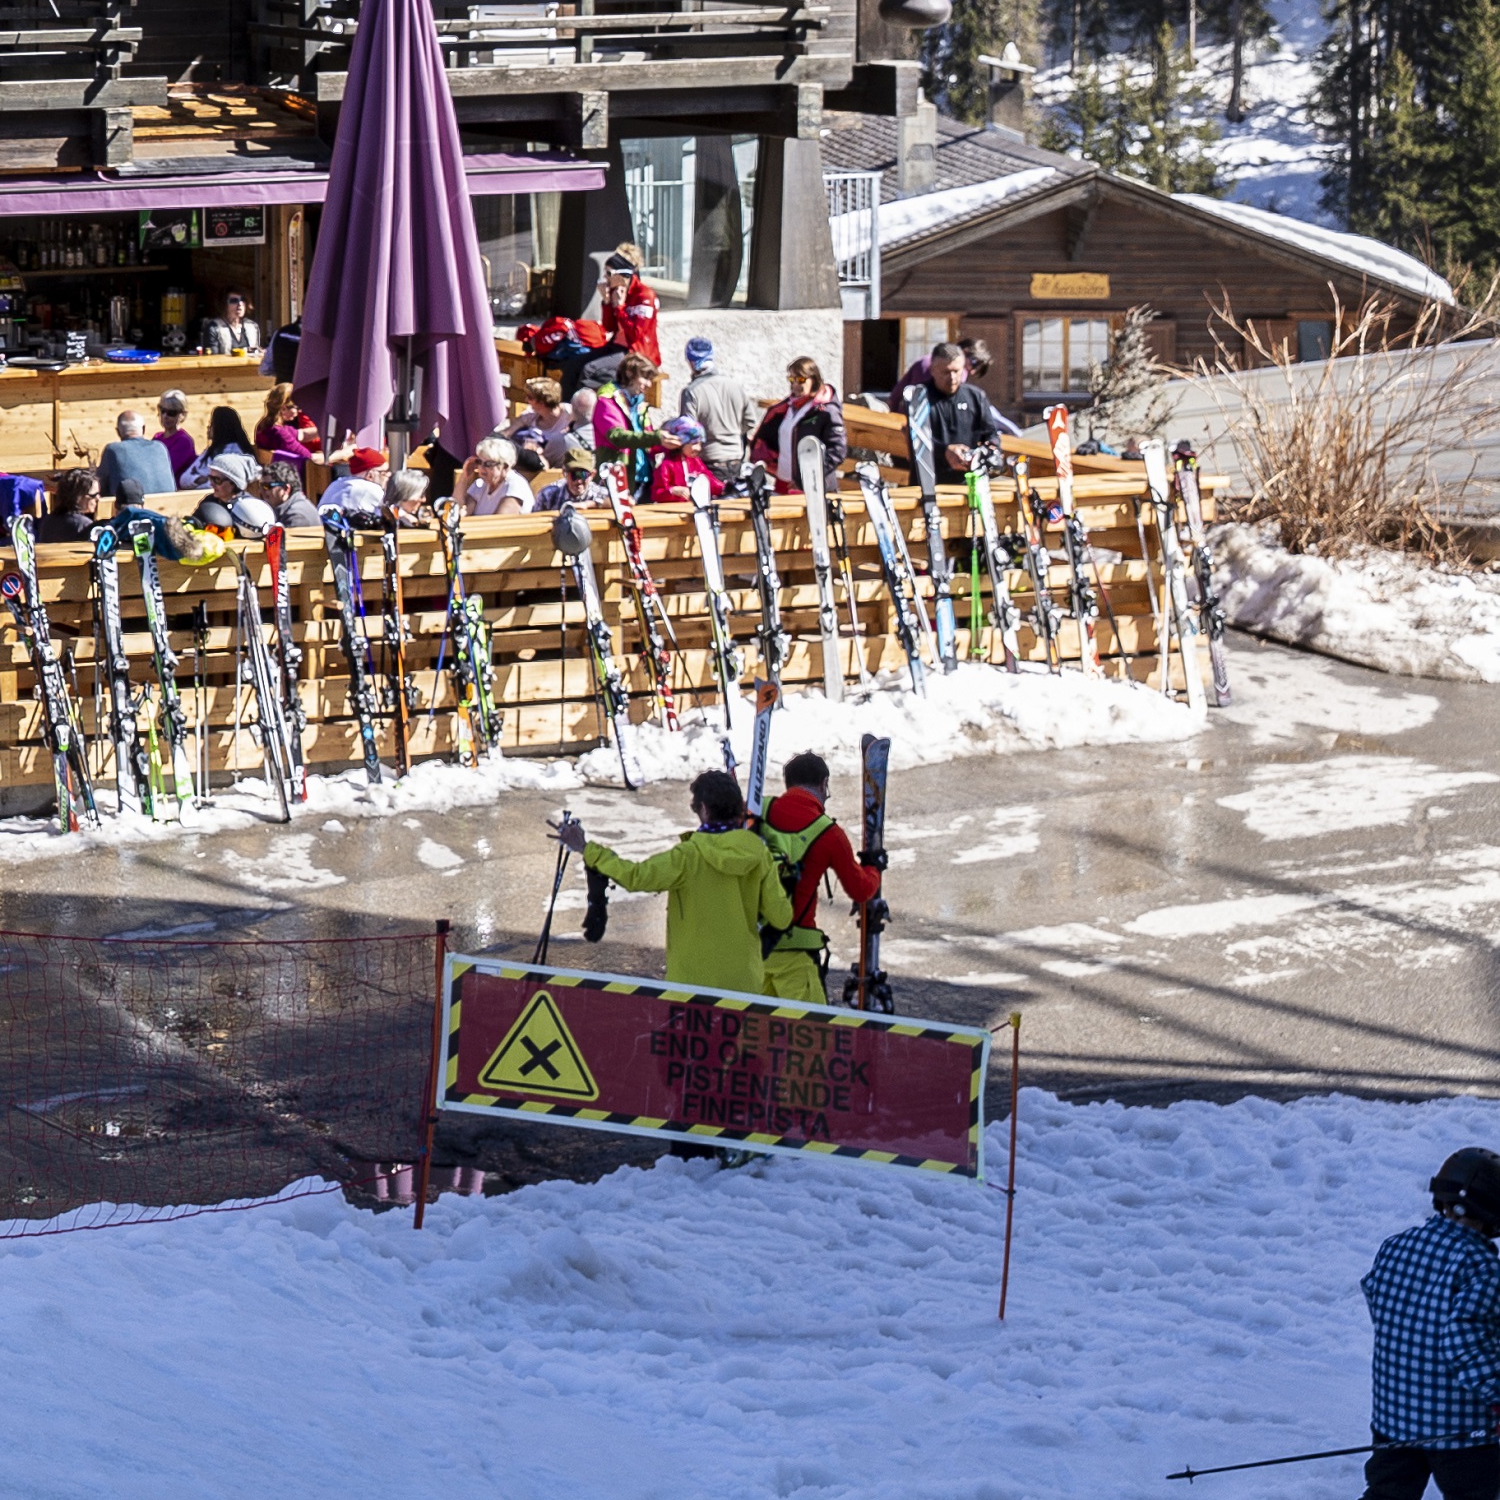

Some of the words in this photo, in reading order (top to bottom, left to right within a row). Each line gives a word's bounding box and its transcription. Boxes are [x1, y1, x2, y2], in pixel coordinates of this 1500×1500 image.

[753, 718, 767, 807] BLIZZARD
[668, 1005, 712, 1034] FIN
[721, 1012, 760, 1042] DE
[767, 1020, 853, 1055] PISTE
[650, 1030, 709, 1061] END
[718, 1040, 758, 1068] OF
[765, 1047, 870, 1086] TRACK
[666, 1061, 851, 1112] PISTENENDE
